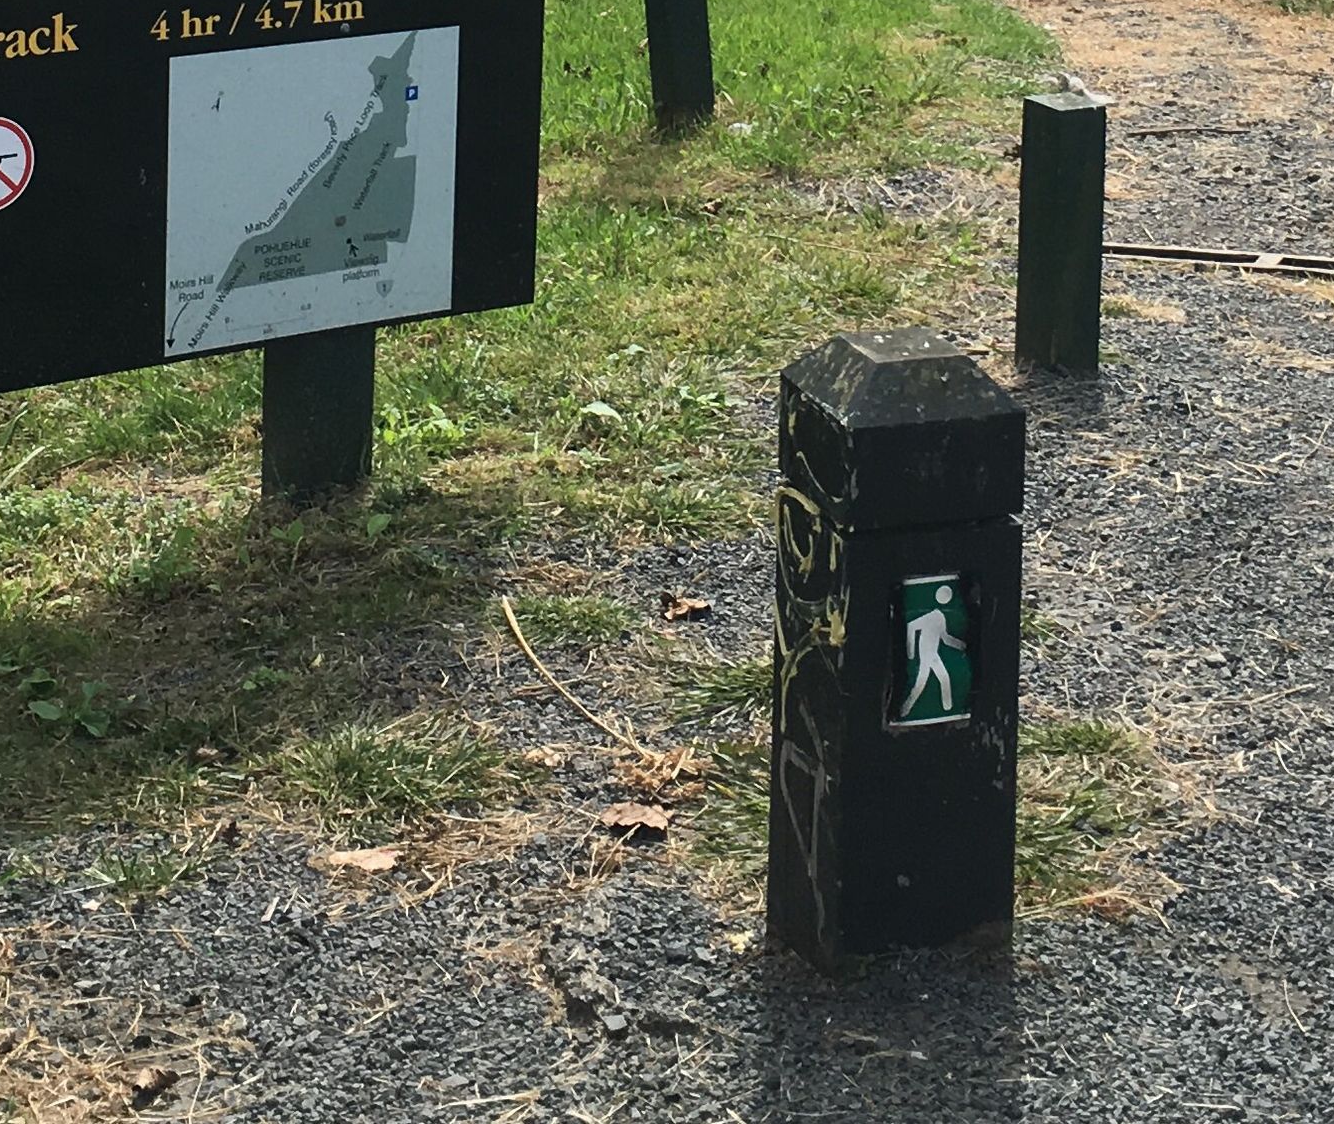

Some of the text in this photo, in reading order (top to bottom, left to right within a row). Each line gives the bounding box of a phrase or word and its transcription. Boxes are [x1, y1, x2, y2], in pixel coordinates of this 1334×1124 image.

[150, 11, 170, 42] 4
[181, 7, 221, 39] hr
[229, 2, 245, 35] /
[255, 0, 302, 31] 4.7
[342, 127, 360, 152] Price
[356, 100, 375, 126] Loop
[244, 198, 288, 234] Mahurangi
[287, 170, 308, 196] Road
[254, 238, 312, 254] POHUEHUE
[264, 253, 302, 268] SCENIC
[259, 266, 305, 281] RESERVE
[170, 274, 214, 290] Moirs Hill
[179, 290, 205, 302] Road
[188, 319, 209, 349] Moirs
[205, 304, 220, 321] Hill
